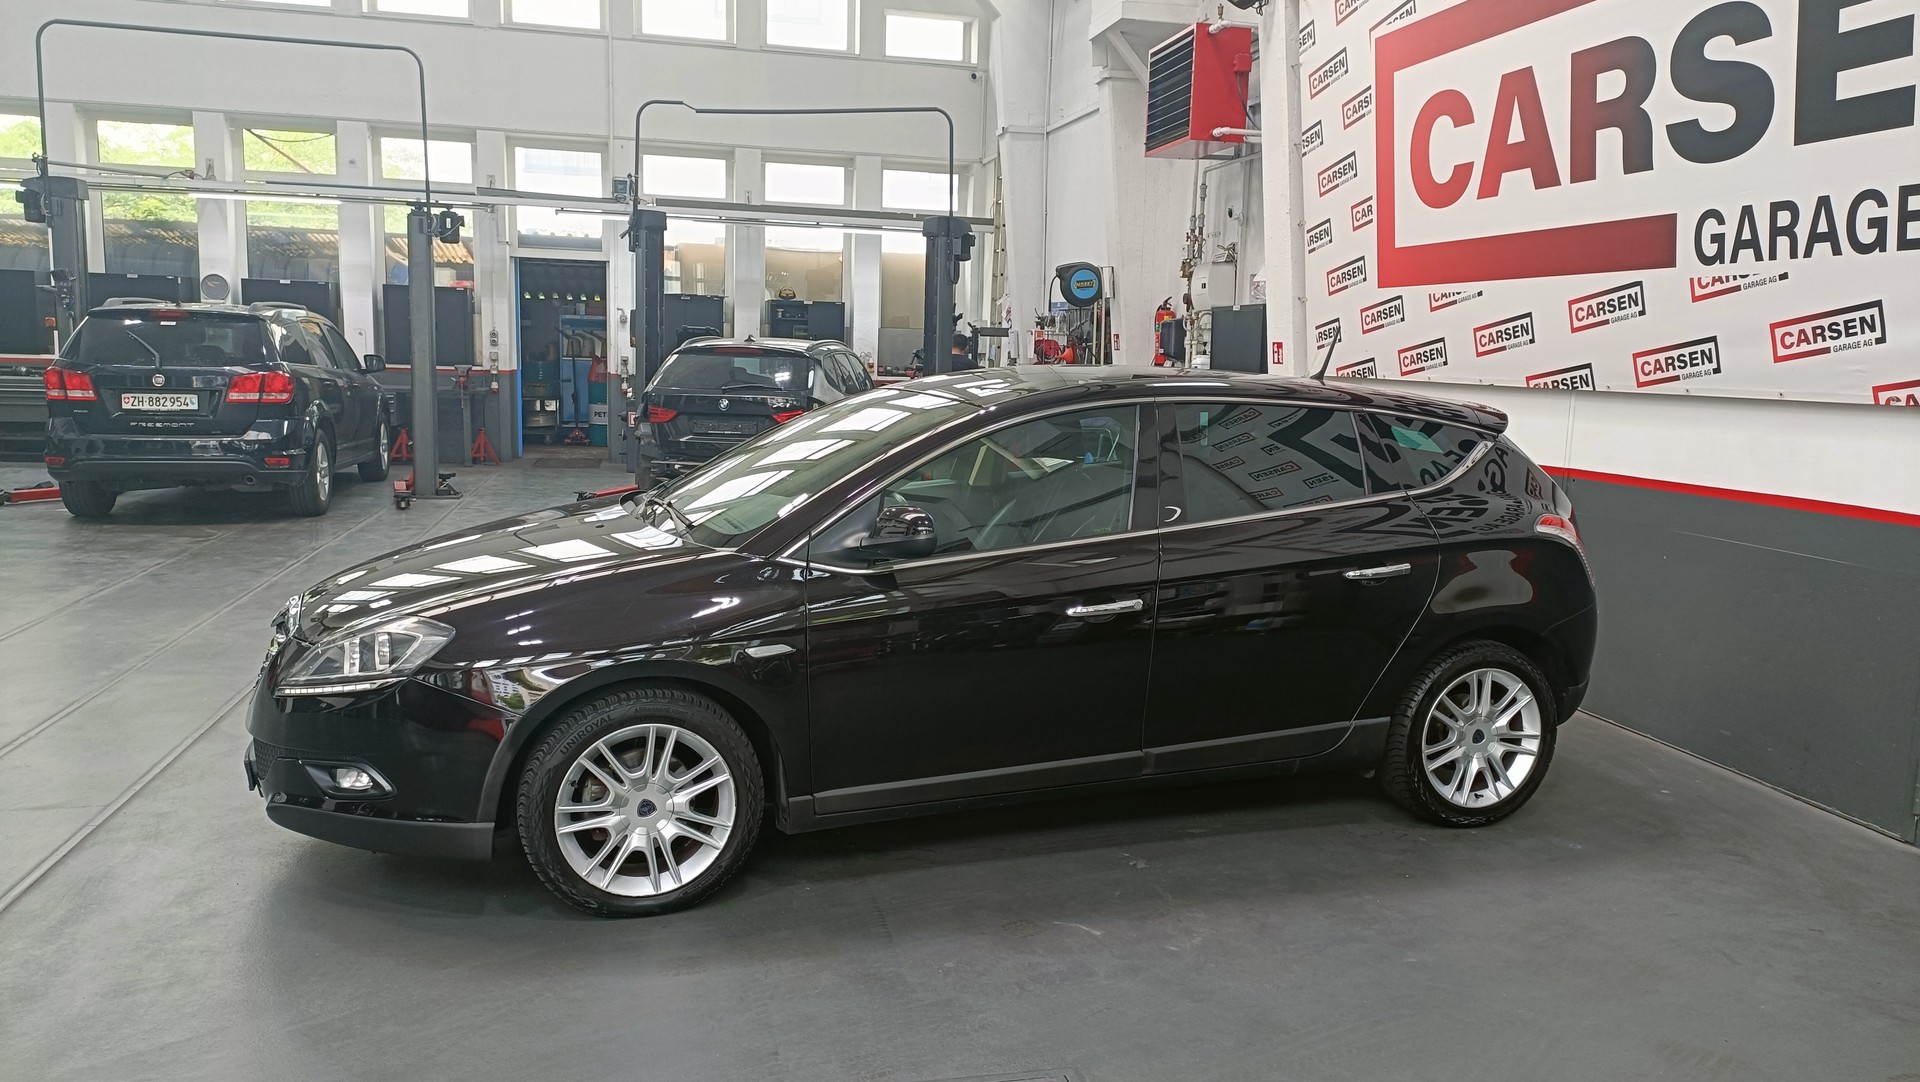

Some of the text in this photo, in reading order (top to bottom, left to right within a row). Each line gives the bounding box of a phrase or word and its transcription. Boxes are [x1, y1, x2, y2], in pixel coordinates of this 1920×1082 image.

[1312, 57, 1345, 90] CARSEN
[1321, 160, 1354, 188] CARSEN
[1694, 184, 1920, 267] GARAGE
[1330, 264, 1363, 288] CARSEN
[1743, 278, 1768, 290] GARAGE
[1769, 276, 1777, 284] AG
[1364, 303, 1401, 326] CARSEN
[1575, 291, 1639, 322] CARSEN
[1479, 322, 1530, 347] CARSEN
[1780, 314, 1877, 349] CARSEN
[1402, 345, 1443, 368] CARSEN
[1833, 338, 1873, 353] GARAGE AG
[1640, 348, 1714, 377] CARSEN
[1681, 370, 1703, 380] GARAGE
[560, 714, 616, 755] UNIROYAL
